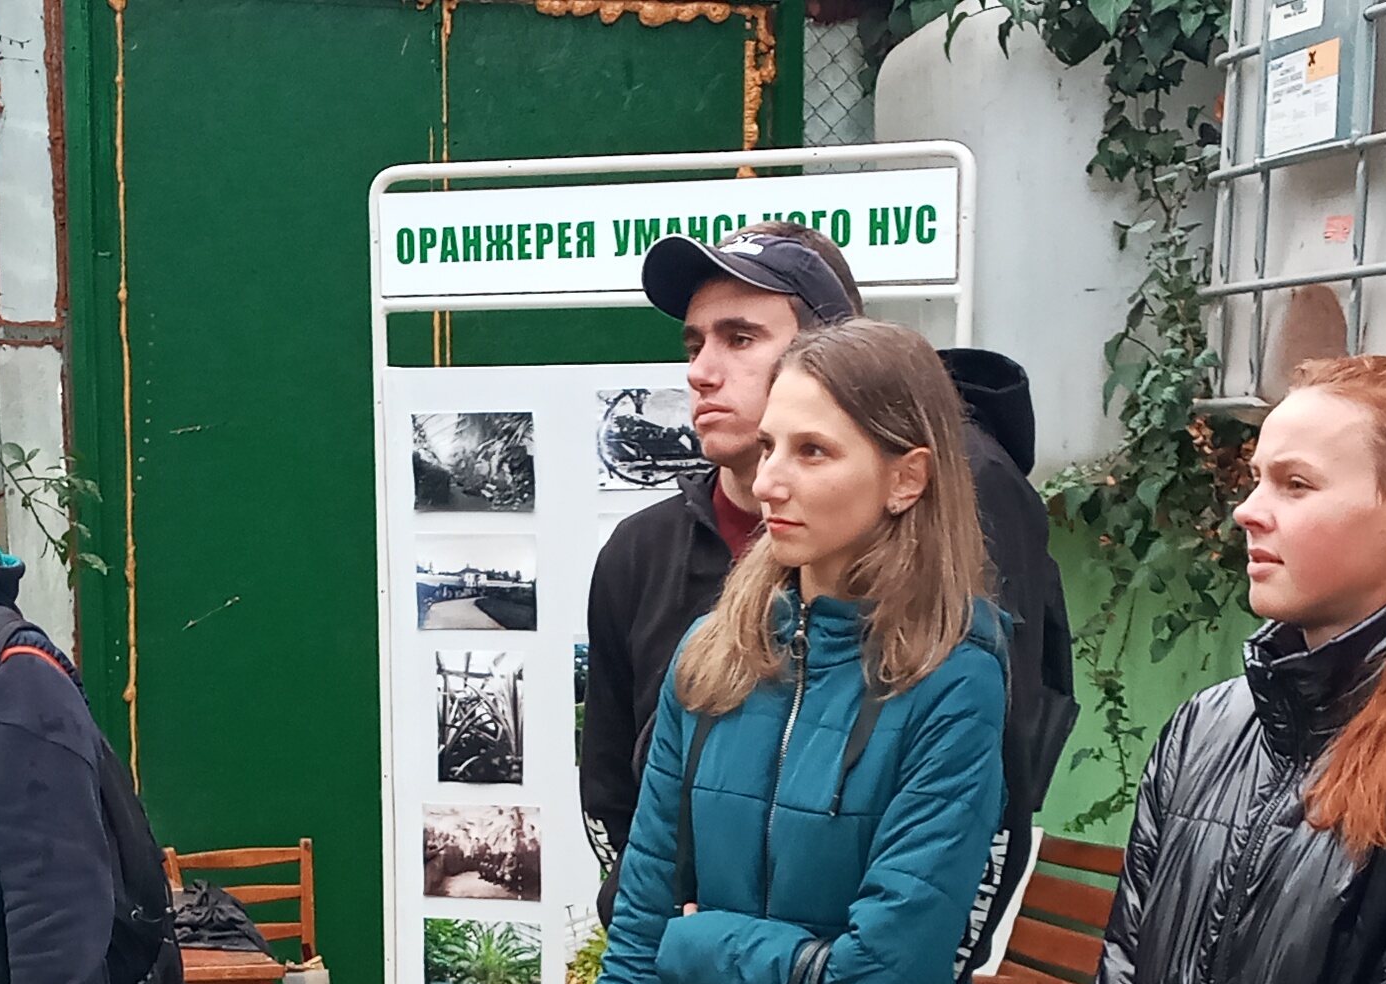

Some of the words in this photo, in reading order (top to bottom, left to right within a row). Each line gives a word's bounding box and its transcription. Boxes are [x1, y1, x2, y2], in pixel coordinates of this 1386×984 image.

[396, 220, 595, 264] ОРАНЖЕРЕЯ
[612, 208, 851, 256] УМНСГО
[868, 204, 938, 246] НУС
